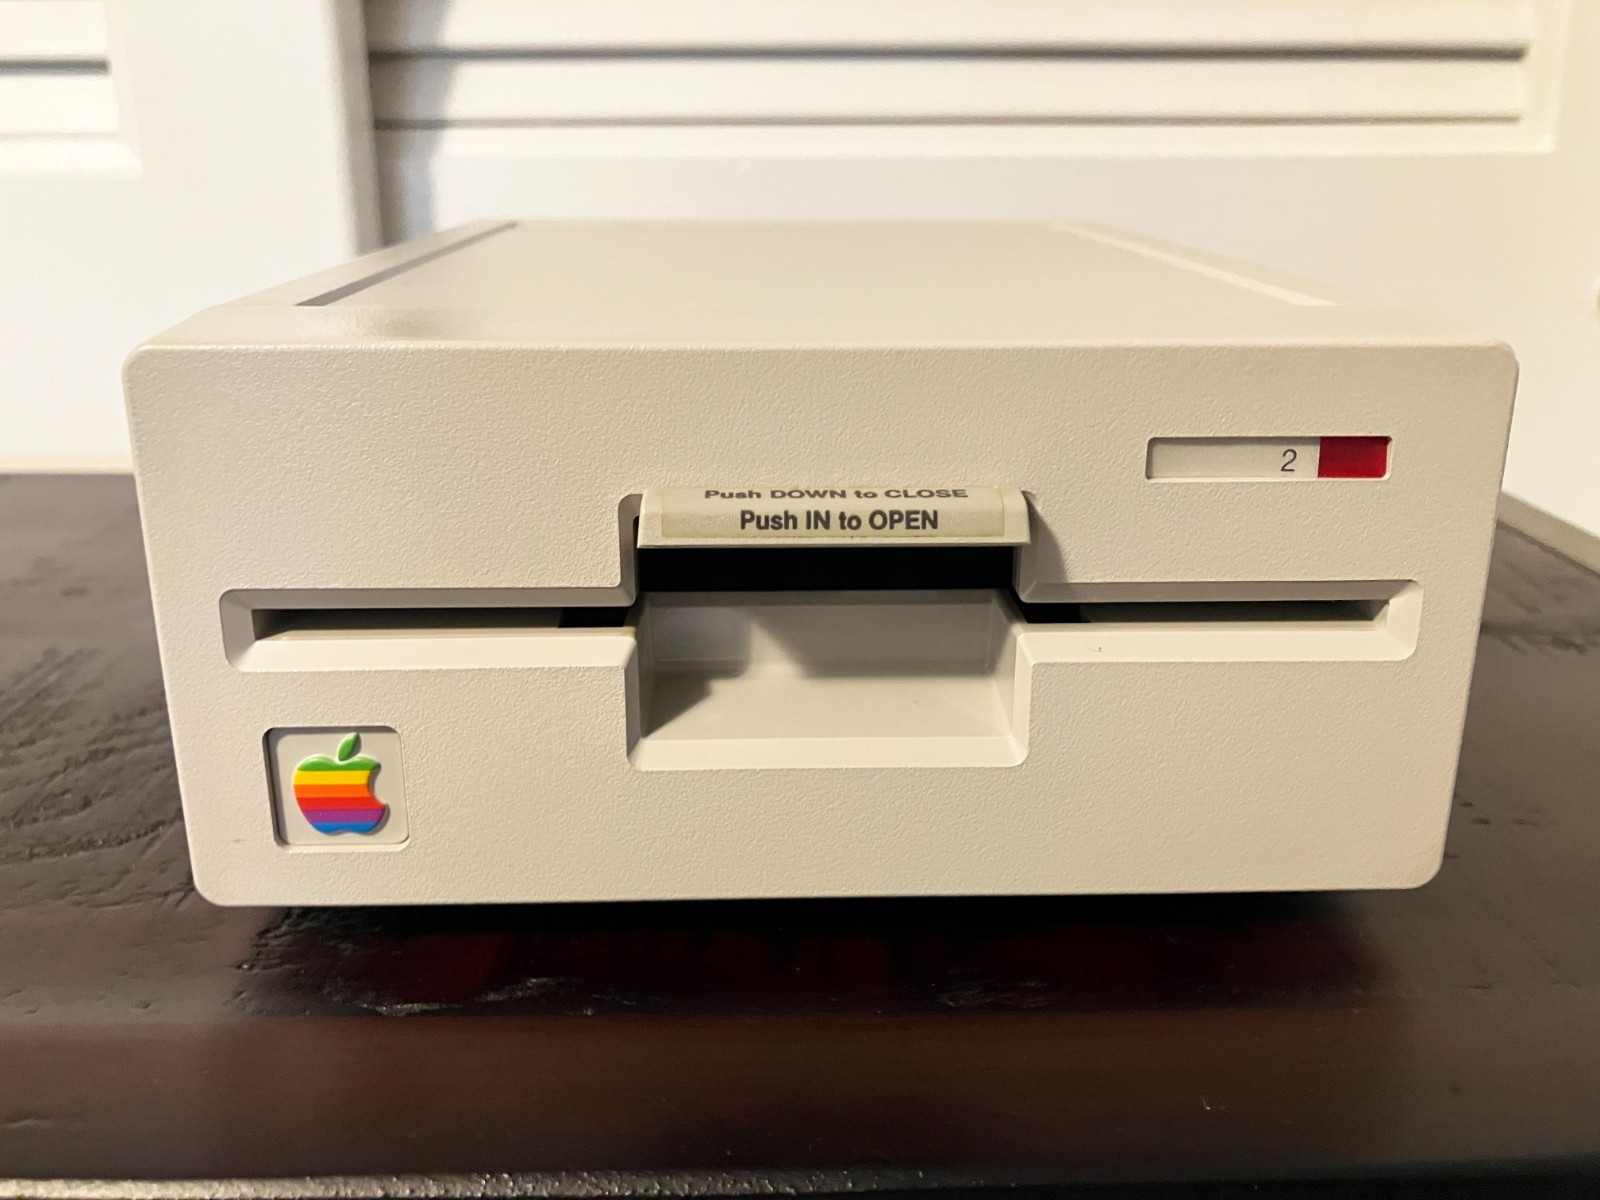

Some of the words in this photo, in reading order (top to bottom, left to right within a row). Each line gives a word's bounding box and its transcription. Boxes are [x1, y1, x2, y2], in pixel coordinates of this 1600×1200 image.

[1280, 448, 1298, 472] 2
[704, 489, 762, 500] Push
[771, 489, 847, 499] DOWN
[854, 489, 878, 499] to
[884, 488, 969, 499] CLOSE
[740, 509, 798, 531] Push
[805, 509, 831, 530] IN
[838, 509, 863, 531] to
[868, 509, 939, 531] OPEN
